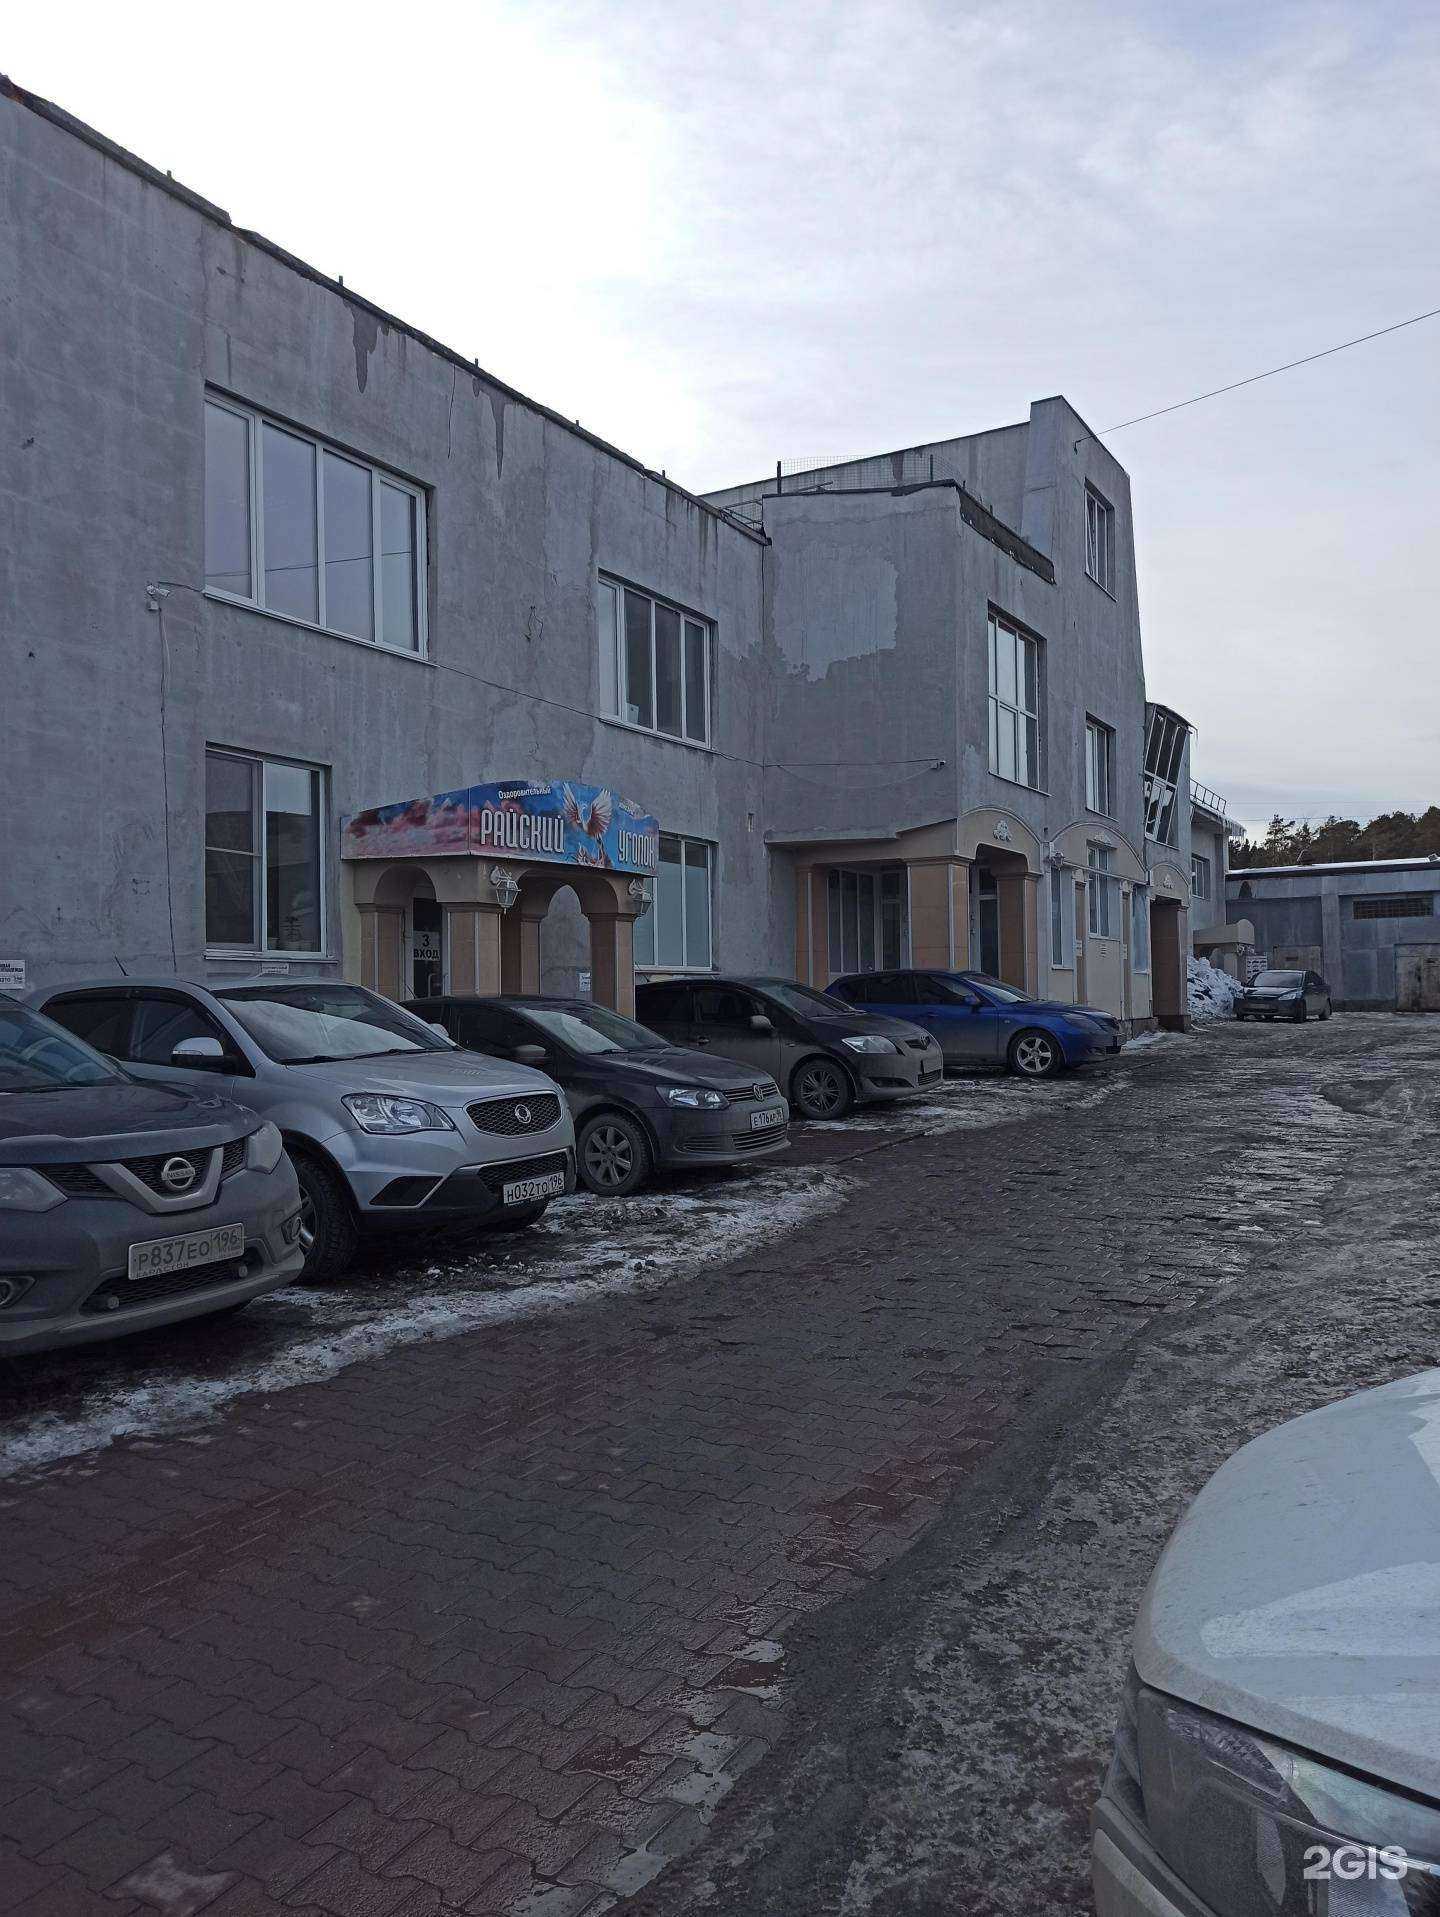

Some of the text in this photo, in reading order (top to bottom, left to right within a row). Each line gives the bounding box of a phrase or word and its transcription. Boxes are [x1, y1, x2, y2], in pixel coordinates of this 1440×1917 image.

[480, 808, 656, 869] РАЙСКИЙ УГОЛОК
[166, 1168, 193, 1179] NISSAN
